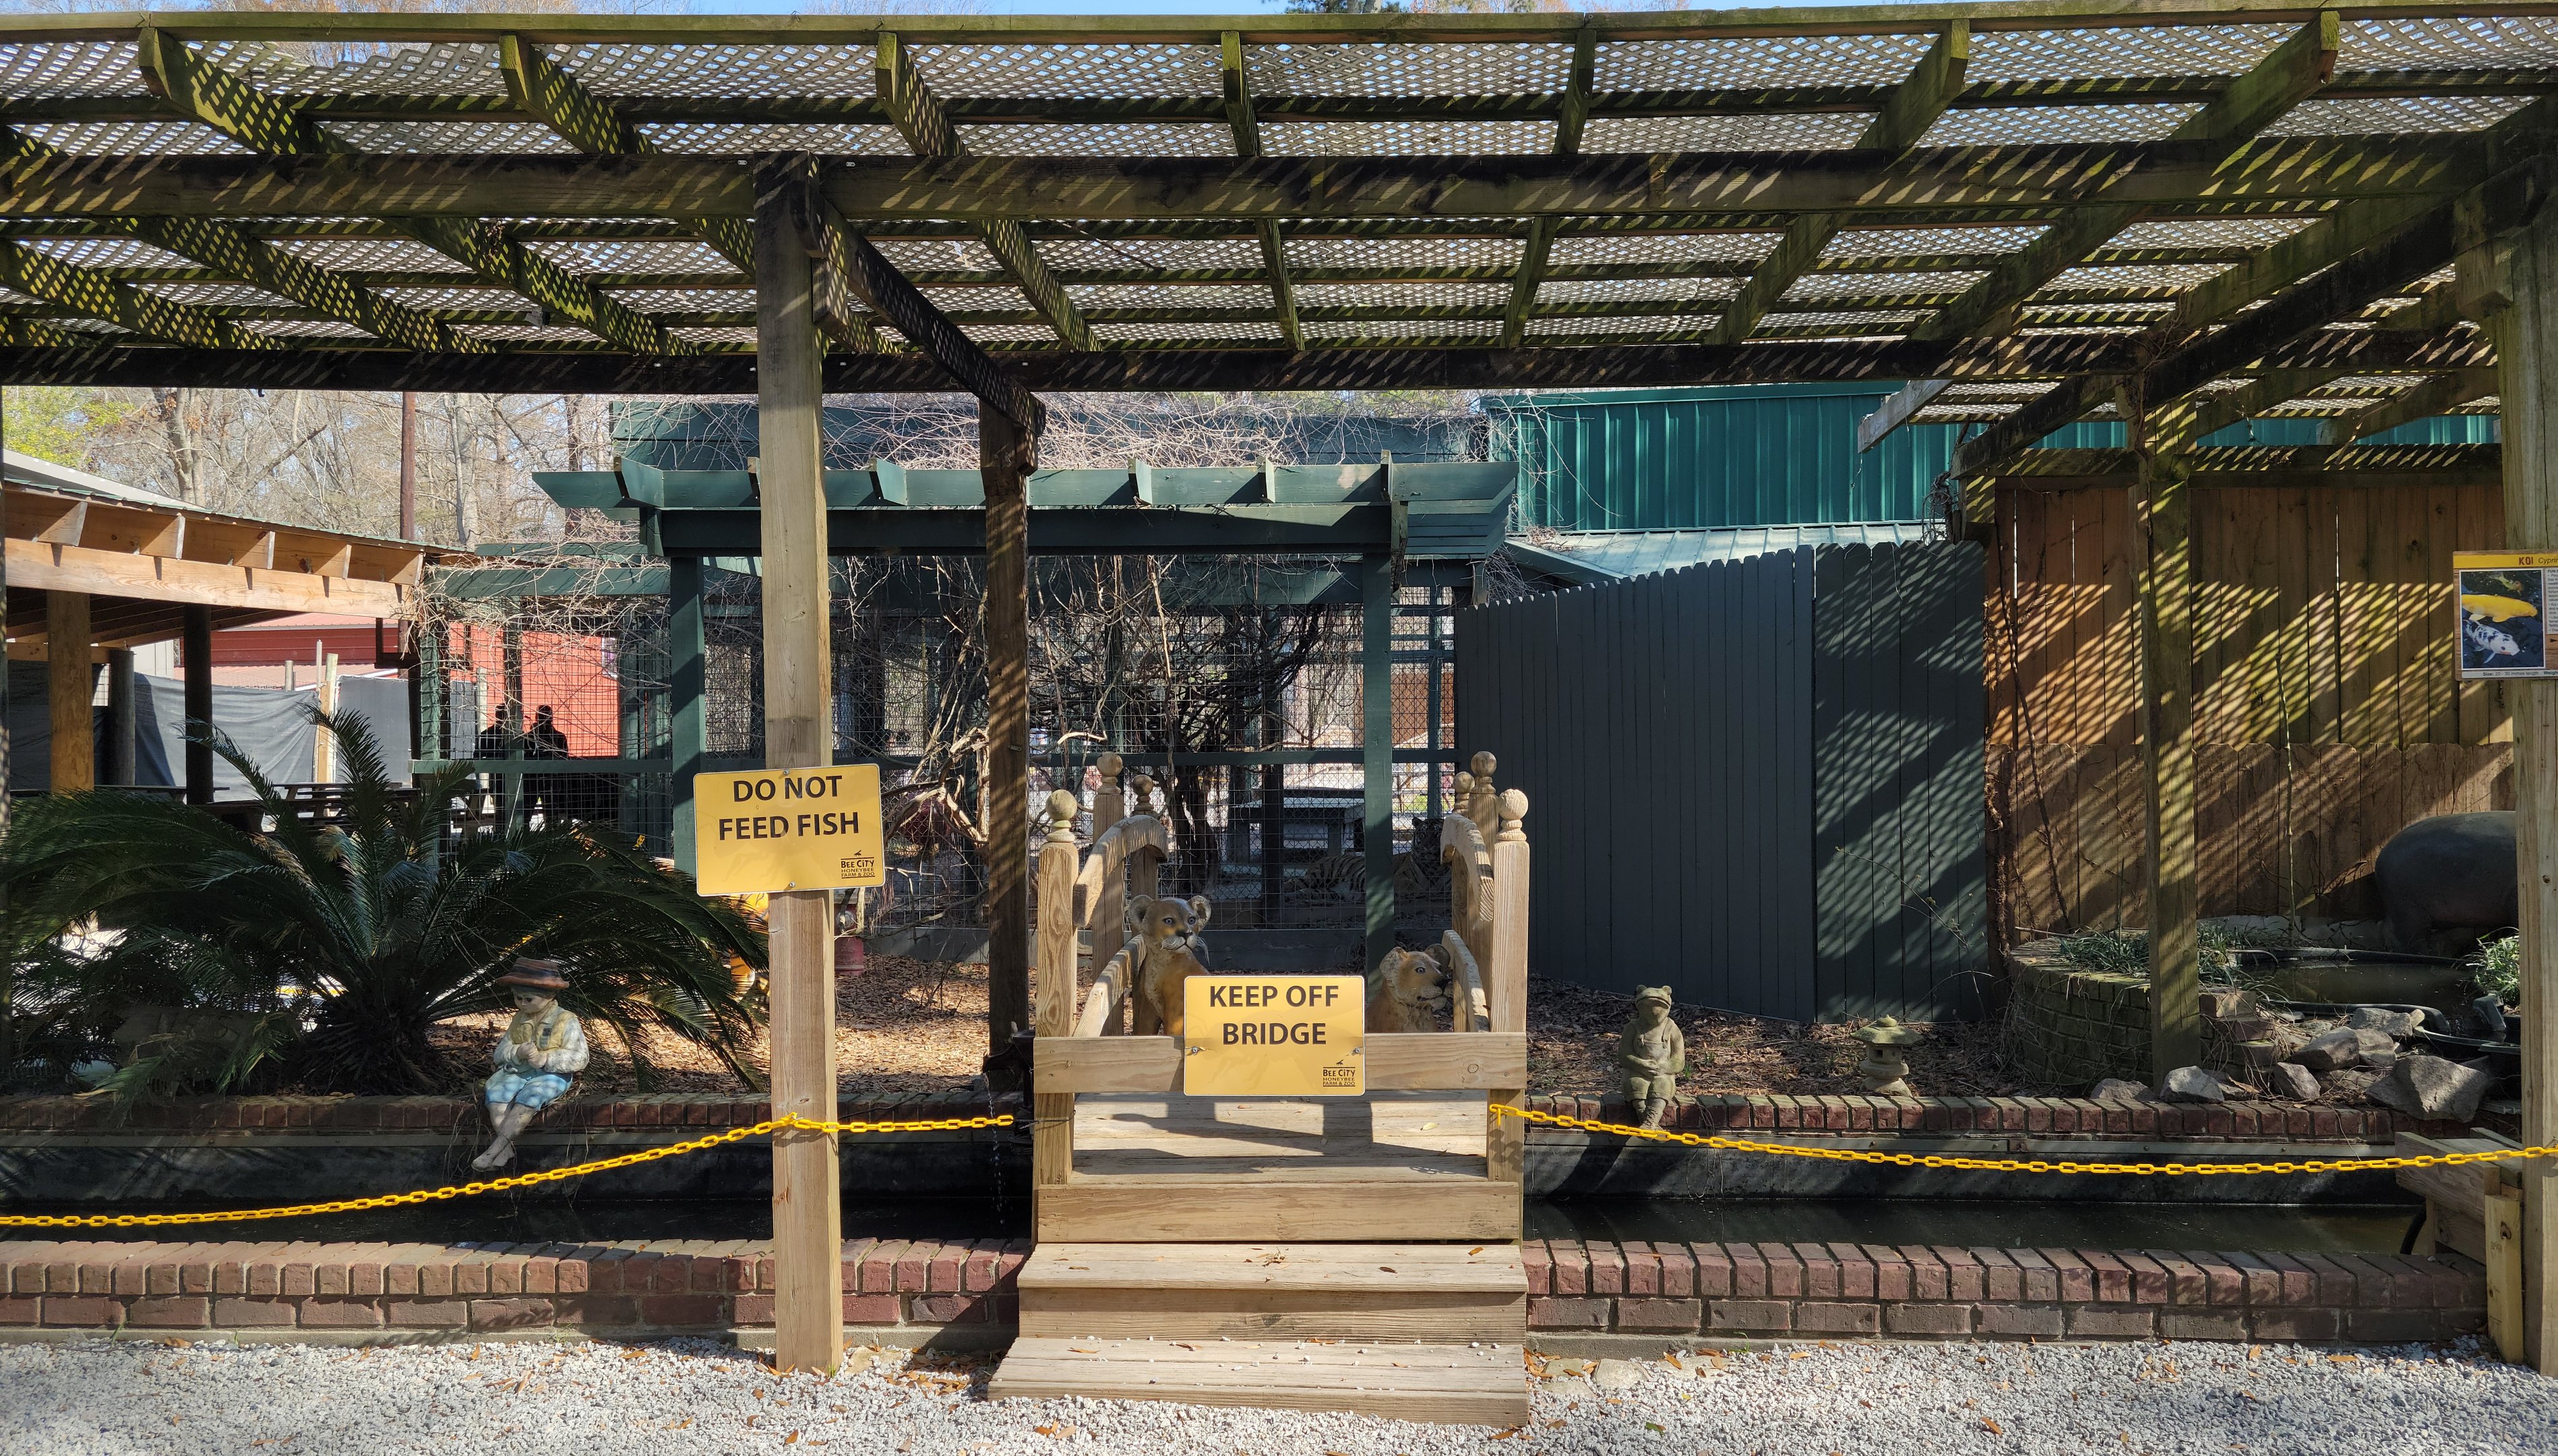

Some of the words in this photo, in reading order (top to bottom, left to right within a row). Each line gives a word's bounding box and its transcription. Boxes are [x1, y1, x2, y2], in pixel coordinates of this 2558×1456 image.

[2519, 556, 2533, 566] KOI
[733, 779, 776, 802] DO
[785, 775, 842, 799] NOT
[719, 816, 789, 841] FEED
[797, 812, 859, 837] FISH
[1210, 985, 1278, 1007] KEEP
[1285, 985, 1339, 1007] OFF
[1223, 1023, 1327, 1045] BRIDGE
